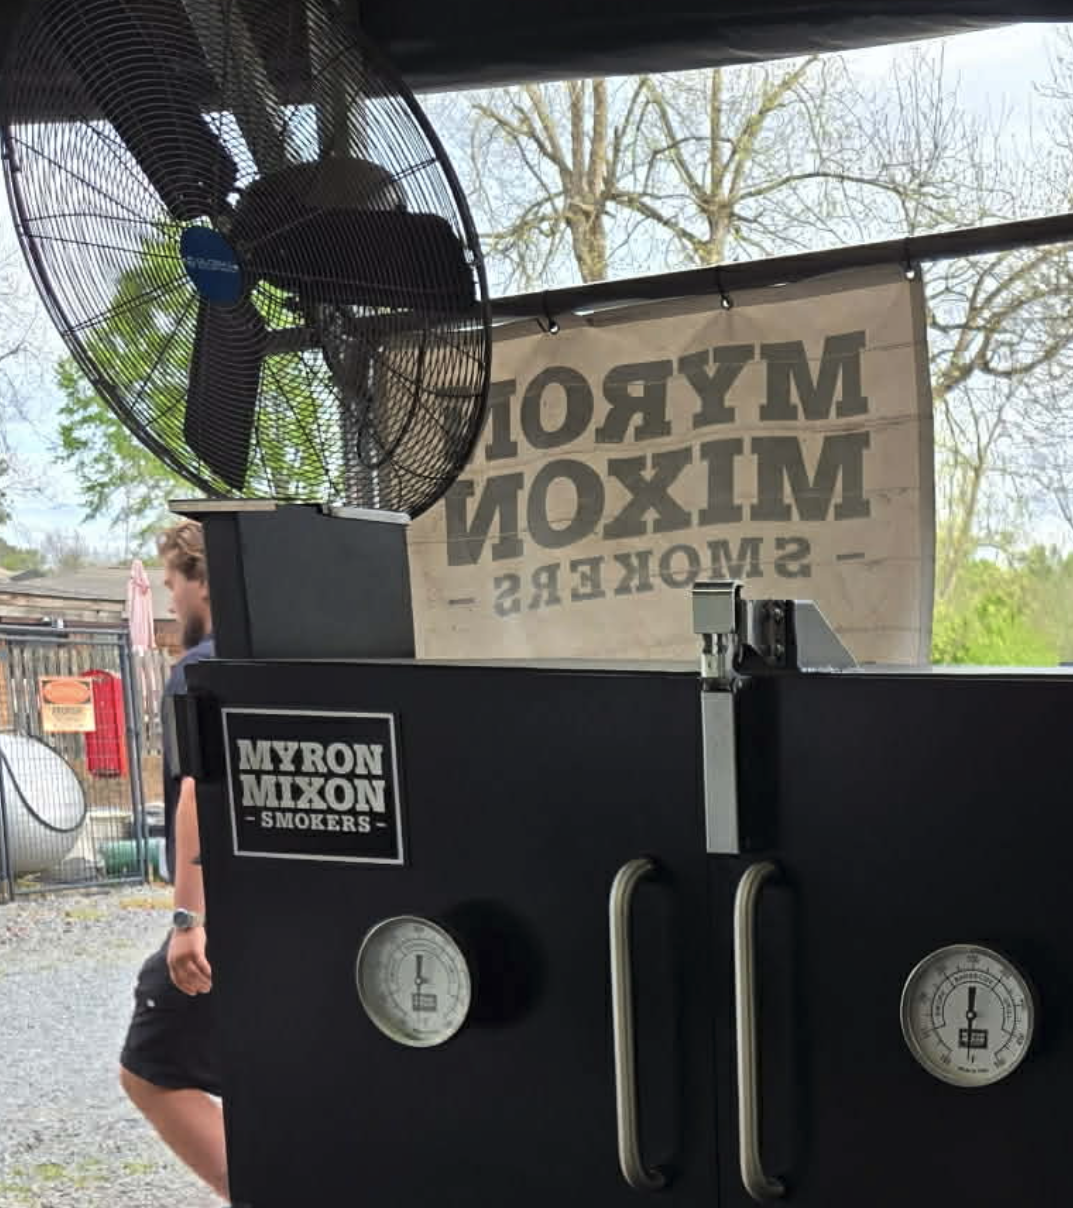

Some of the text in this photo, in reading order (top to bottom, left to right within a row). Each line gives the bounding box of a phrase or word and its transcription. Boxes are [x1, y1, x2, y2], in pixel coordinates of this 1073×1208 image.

[236, 739, 383, 775] MYRON
[239, 774, 386, 813] MIXON
[261, 811, 371, 833] SMOKERS
